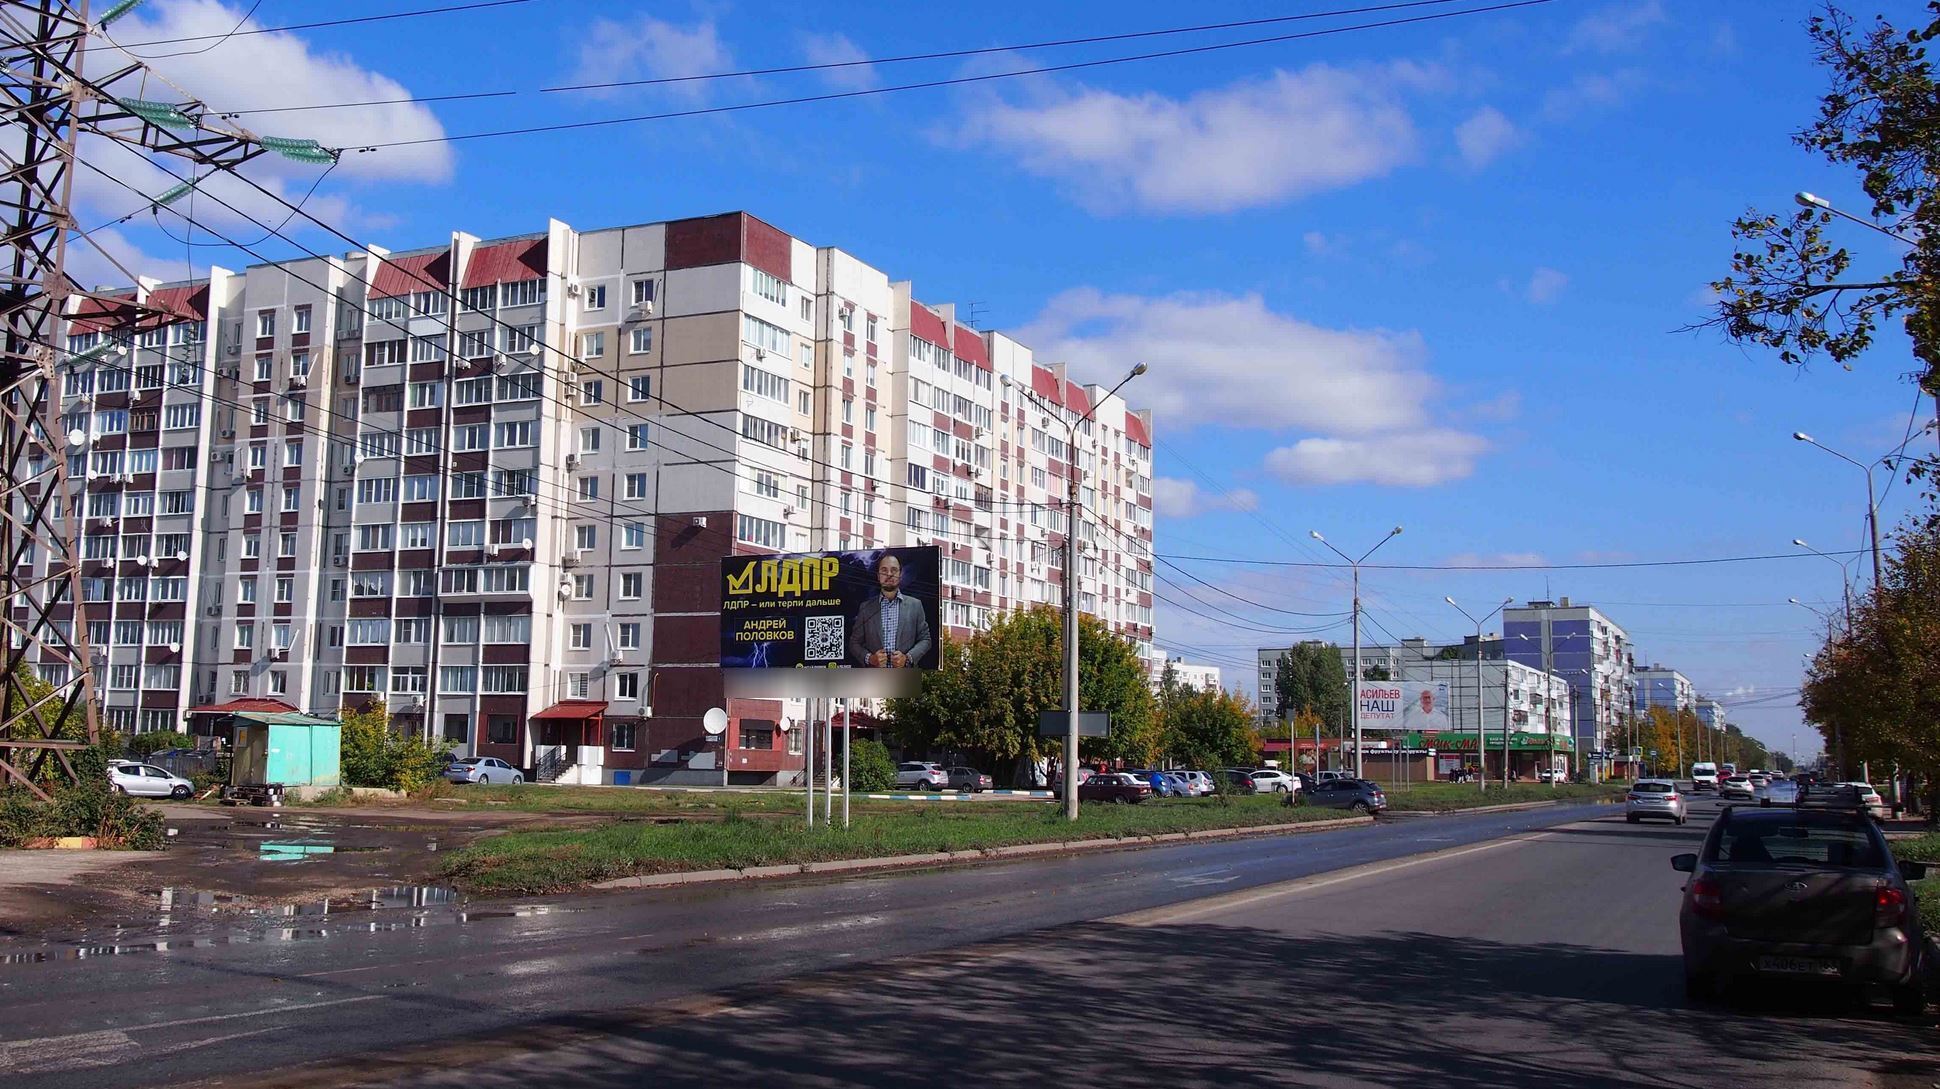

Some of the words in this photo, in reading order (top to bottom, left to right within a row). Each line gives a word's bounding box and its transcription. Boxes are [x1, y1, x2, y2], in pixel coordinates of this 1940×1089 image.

[755, 557, 839, 597] ЛДПР
[723, 601, 750, 610] ЛДПР
[778, 600, 804, 609] терпи
[806, 598, 841, 608] дальше
[743, 618, 786, 630] АНДРЕЙ
[735, 631, 795, 642] ПОЛОВКОВ
[1359, 689, 1400, 699] АСИЛЬЕВ
[1360, 700, 1395, 712] НАШ
